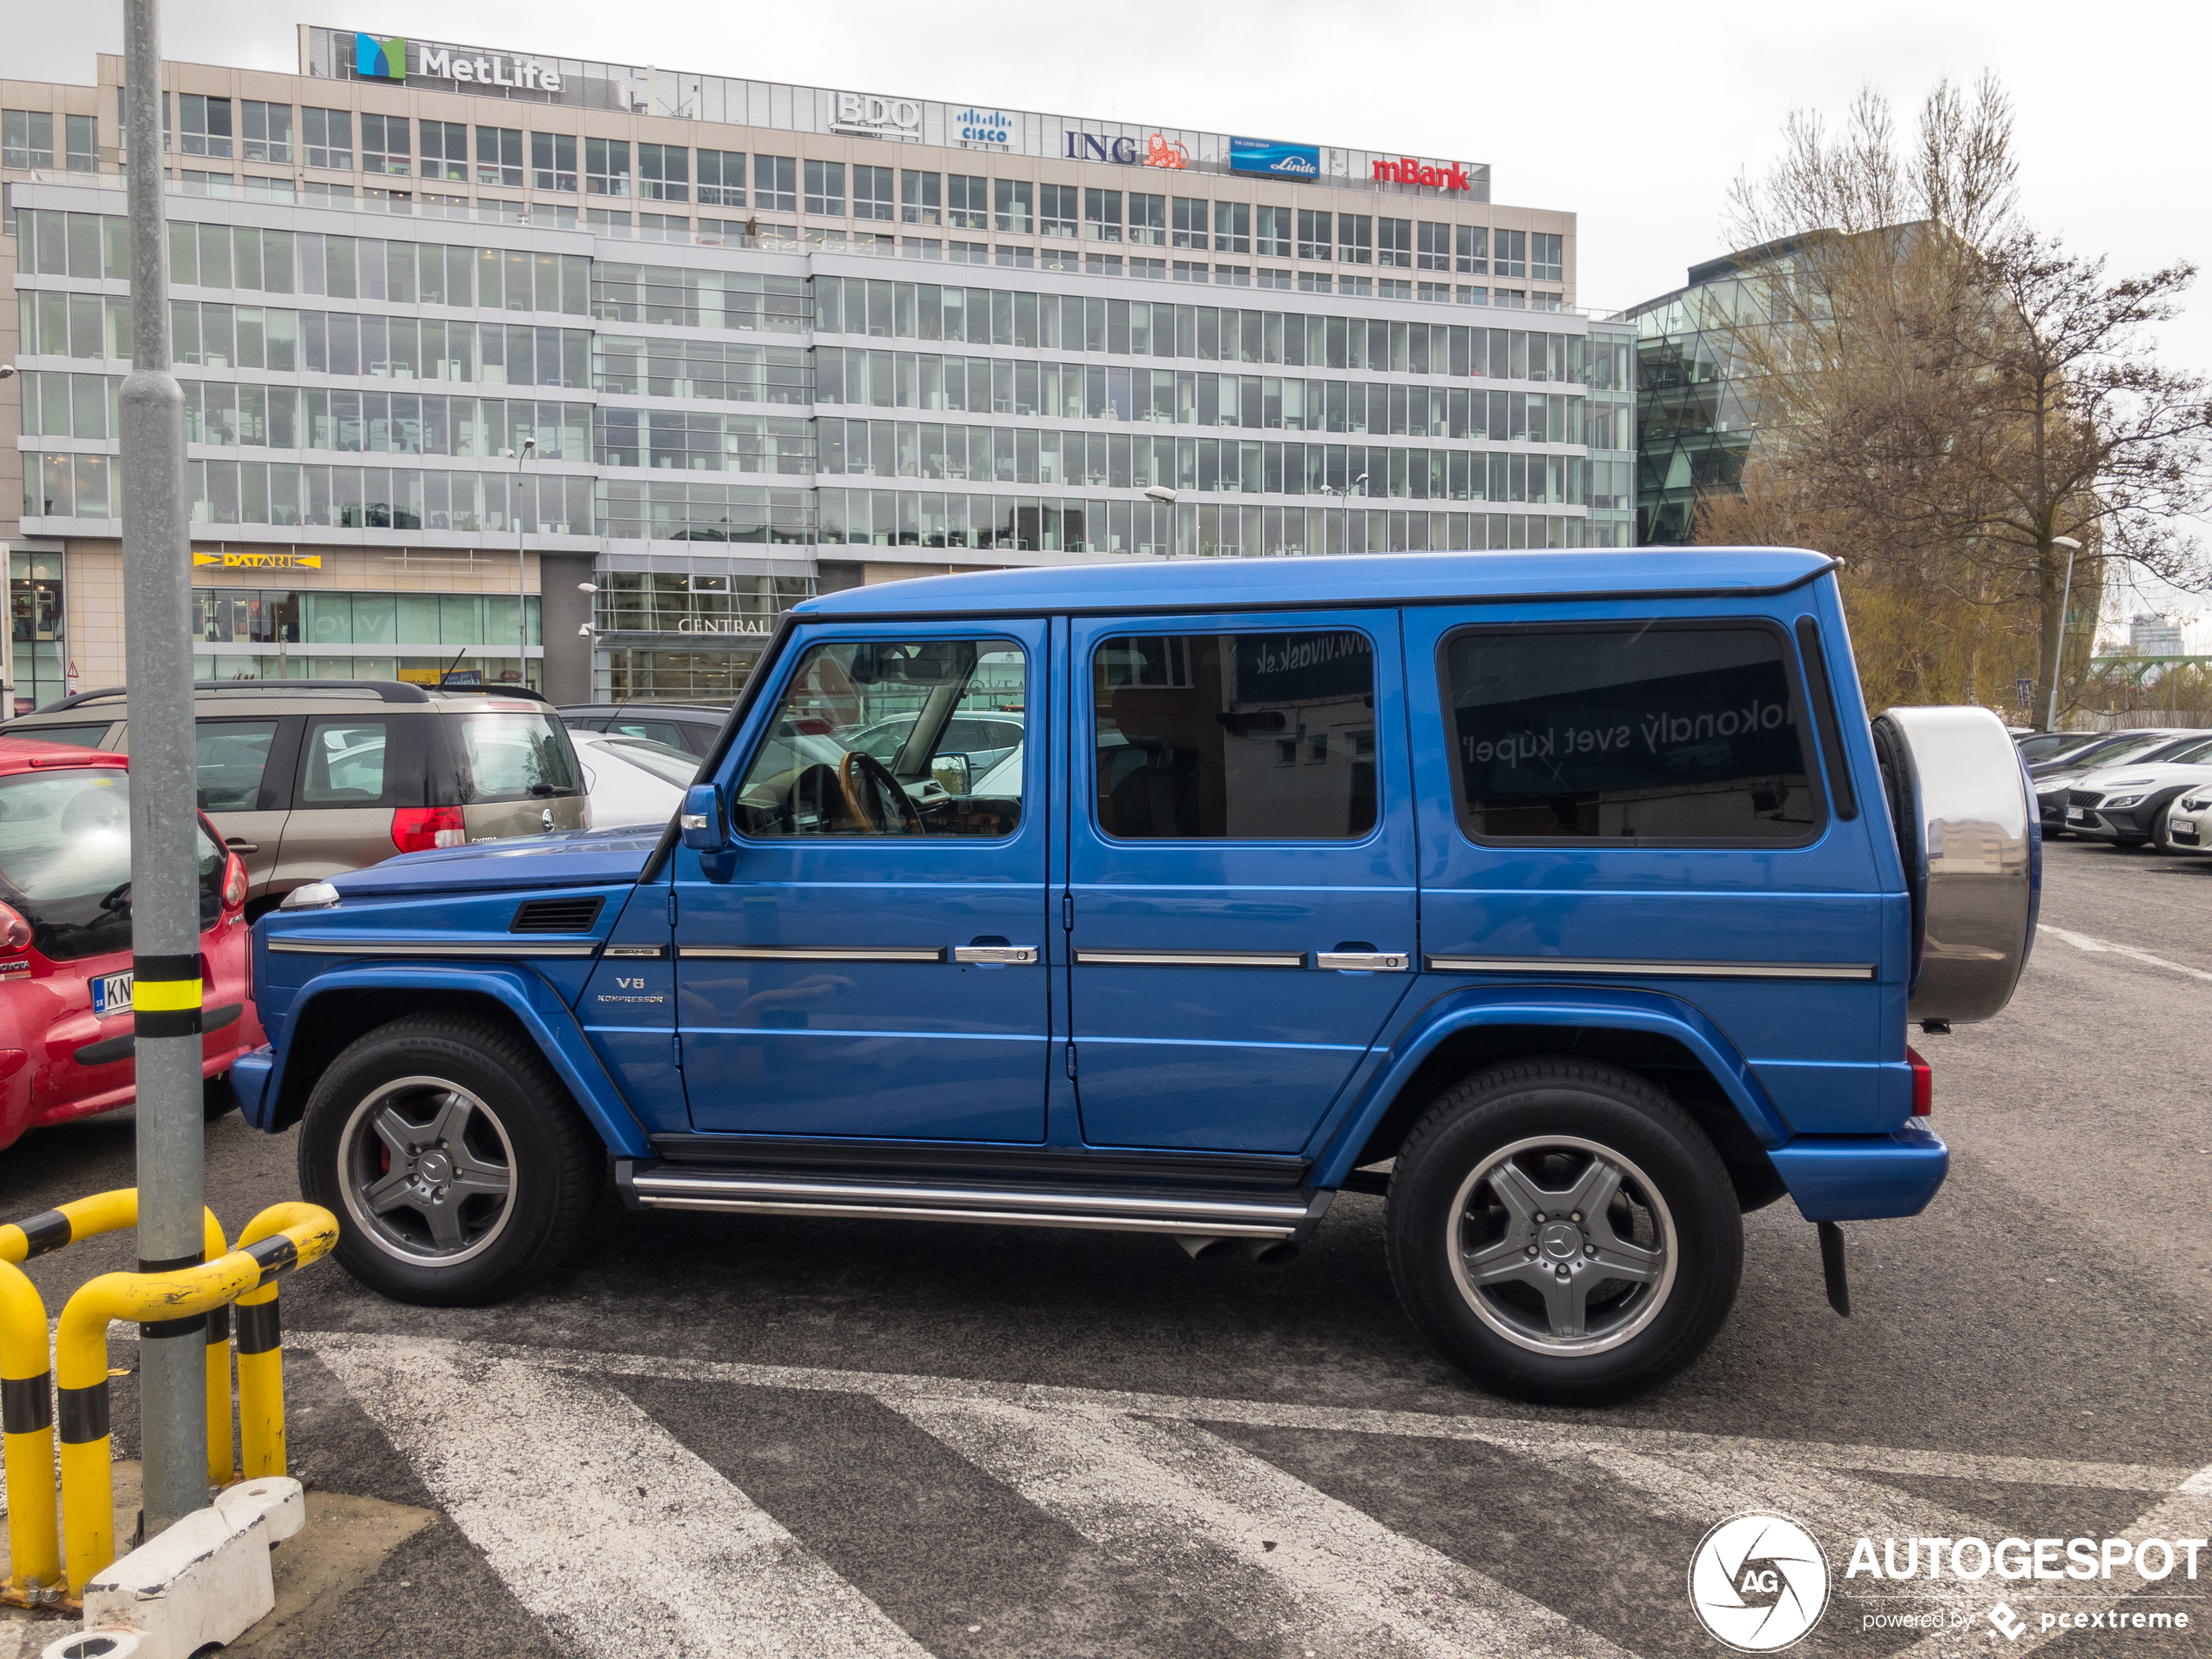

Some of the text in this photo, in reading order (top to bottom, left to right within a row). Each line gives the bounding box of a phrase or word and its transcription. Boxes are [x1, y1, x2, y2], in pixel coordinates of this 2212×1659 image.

[419, 46, 561, 91] MetLife
[837, 91, 920, 128] BDO
[1065, 131, 1138, 165] ING
[1271, 156, 1317, 174] Linde
[1372, 157, 1471, 191] mBank
[224, 553, 298, 569] DATART
[678, 618, 766, 634] CENTRAL
[0, 960, 30, 971] OYOTA
[615, 977, 645, 989] V8
[96, 998, 105, 1008] SK
[597, 995, 664, 1003] KOMPRESSOR
